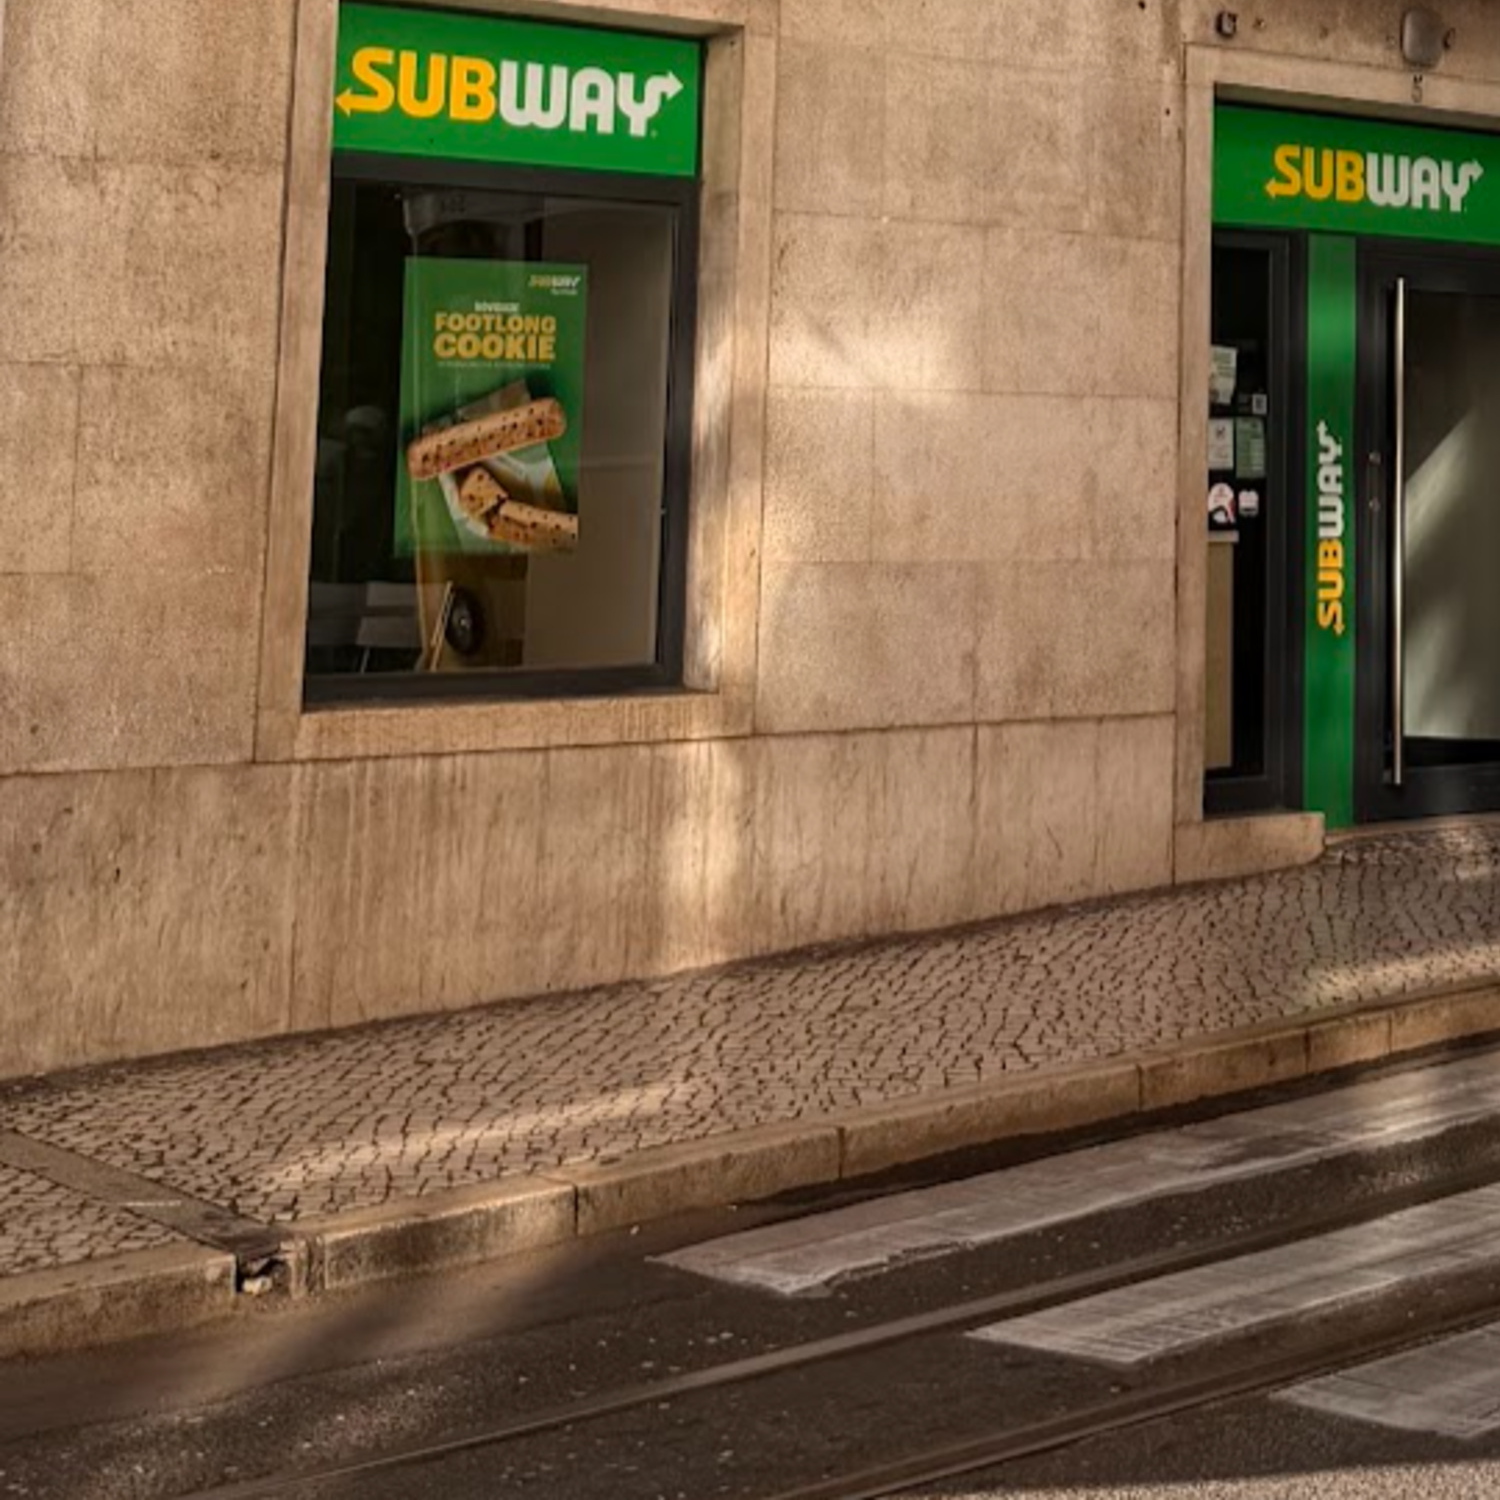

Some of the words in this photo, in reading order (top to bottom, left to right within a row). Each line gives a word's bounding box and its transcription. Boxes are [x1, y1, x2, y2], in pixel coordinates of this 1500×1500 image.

[335, 46, 684, 137] SUBWAY
[1264, 143, 1485, 212] SUBWAY
[433, 332, 556, 361] COOKIE
[434, 312, 557, 334] FOOTLONG
[1316, 420, 1345, 638] SUBWAY
